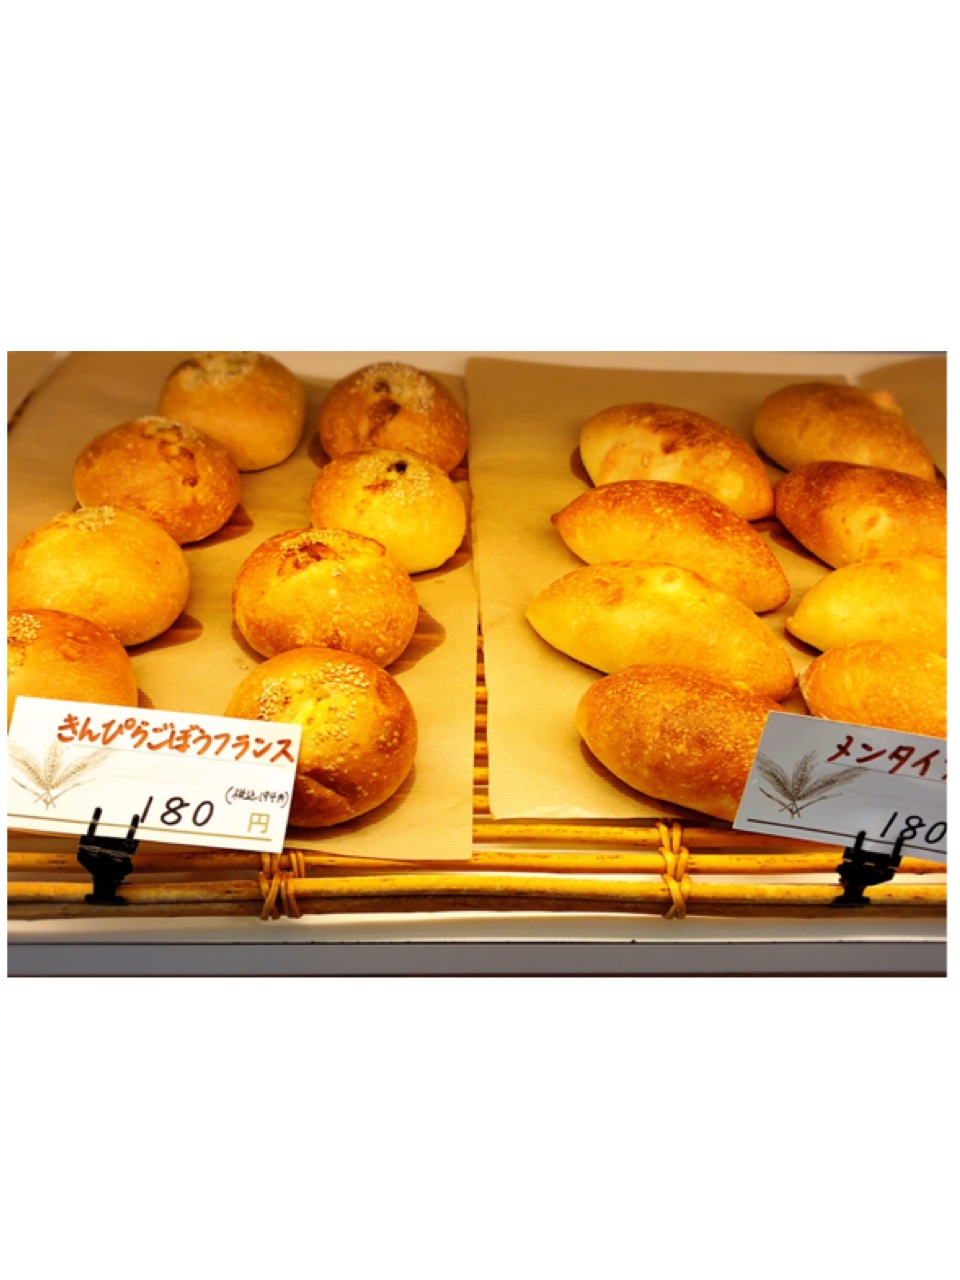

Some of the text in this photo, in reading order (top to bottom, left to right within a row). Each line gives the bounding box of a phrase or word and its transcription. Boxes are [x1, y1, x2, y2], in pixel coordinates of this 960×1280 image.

[57, 713, 294, 763] きんぴらごぼうフランス
[827, 735, 947, 780] メンタイ
[140, 796, 271, 833] 180 円
[880, 811, 947, 844] 180
